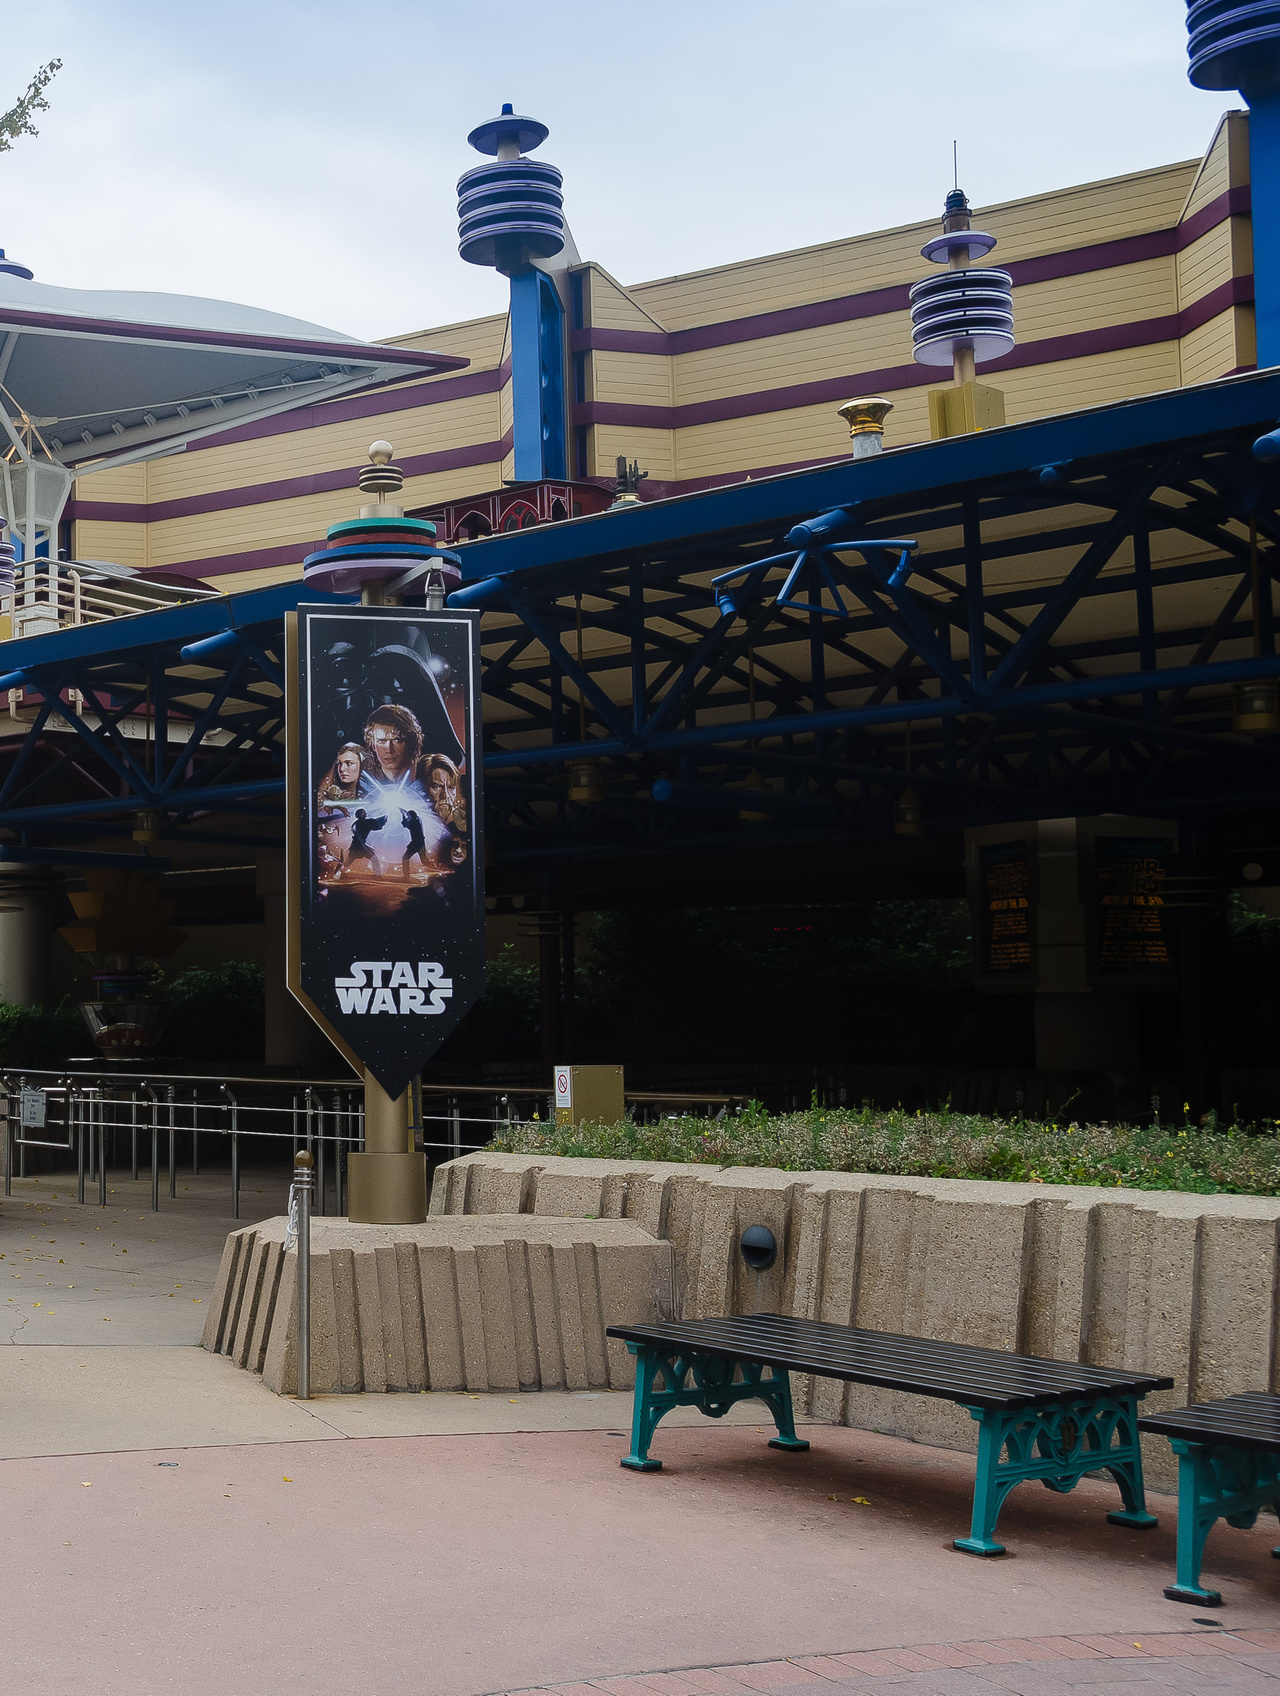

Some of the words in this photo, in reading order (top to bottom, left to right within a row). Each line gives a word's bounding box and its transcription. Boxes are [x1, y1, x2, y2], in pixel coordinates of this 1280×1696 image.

[987, 862, 1028, 881] STAR
[1098, 859, 1166, 877] STAR
[987, 879, 1028, 899] WARS
[1098, 876, 1165, 895] WARS
[1008, 898, 1018, 909] THE
[1132, 896, 1147, 906] THE
[334, 961, 453, 988] STAR
[334, 988, 453, 1015] WARS
